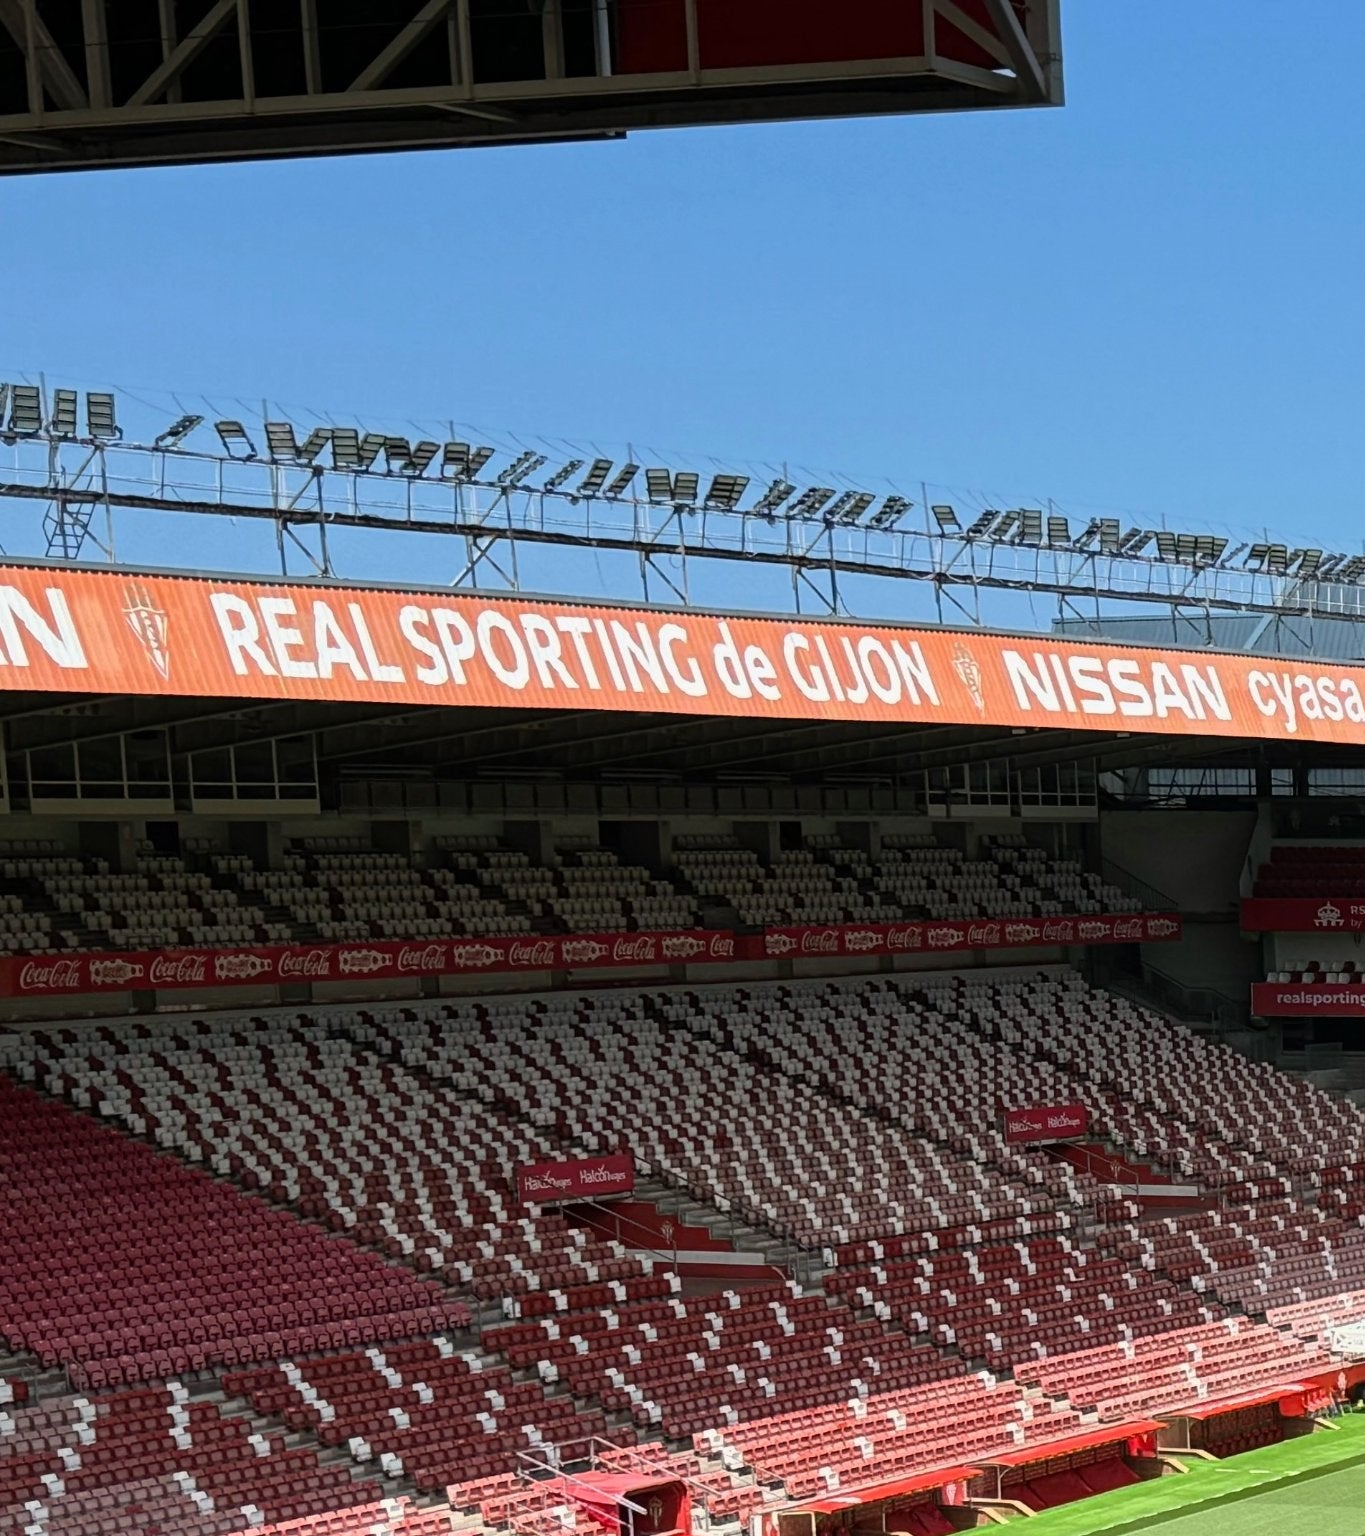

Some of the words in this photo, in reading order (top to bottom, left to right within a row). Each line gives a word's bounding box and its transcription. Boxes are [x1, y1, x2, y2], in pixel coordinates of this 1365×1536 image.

[209, 592, 406, 684] REAL
[398, 608, 705, 697] SPORTING
[713, 621, 782, 701] de
[783, 632, 943, 706] GIJON
[1002, 649, 1232, 720] NISSAN
